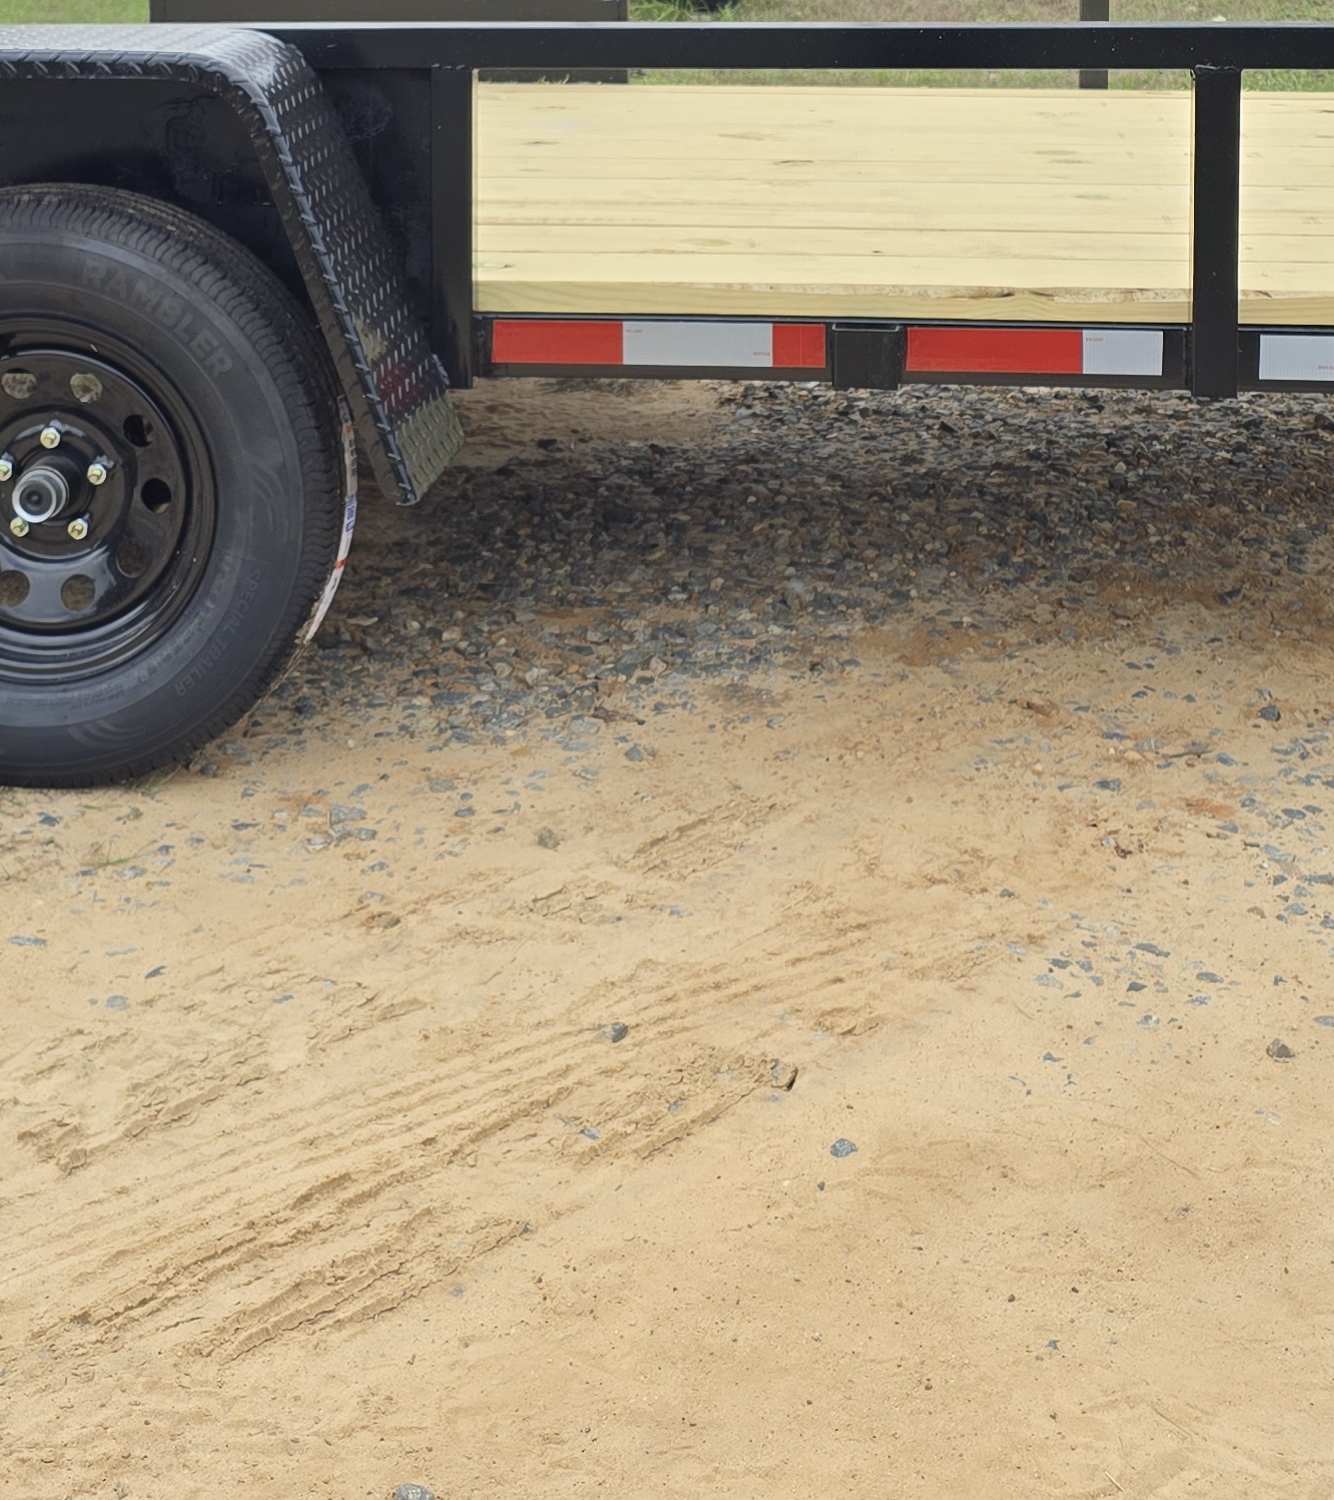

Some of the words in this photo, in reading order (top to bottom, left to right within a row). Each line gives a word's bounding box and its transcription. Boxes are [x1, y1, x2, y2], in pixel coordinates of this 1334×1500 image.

[80, 257, 235, 380] RAMBLER
[222, 568, 262, 636] SPECIAL
[171, 637, 228, 697] TRAILER
